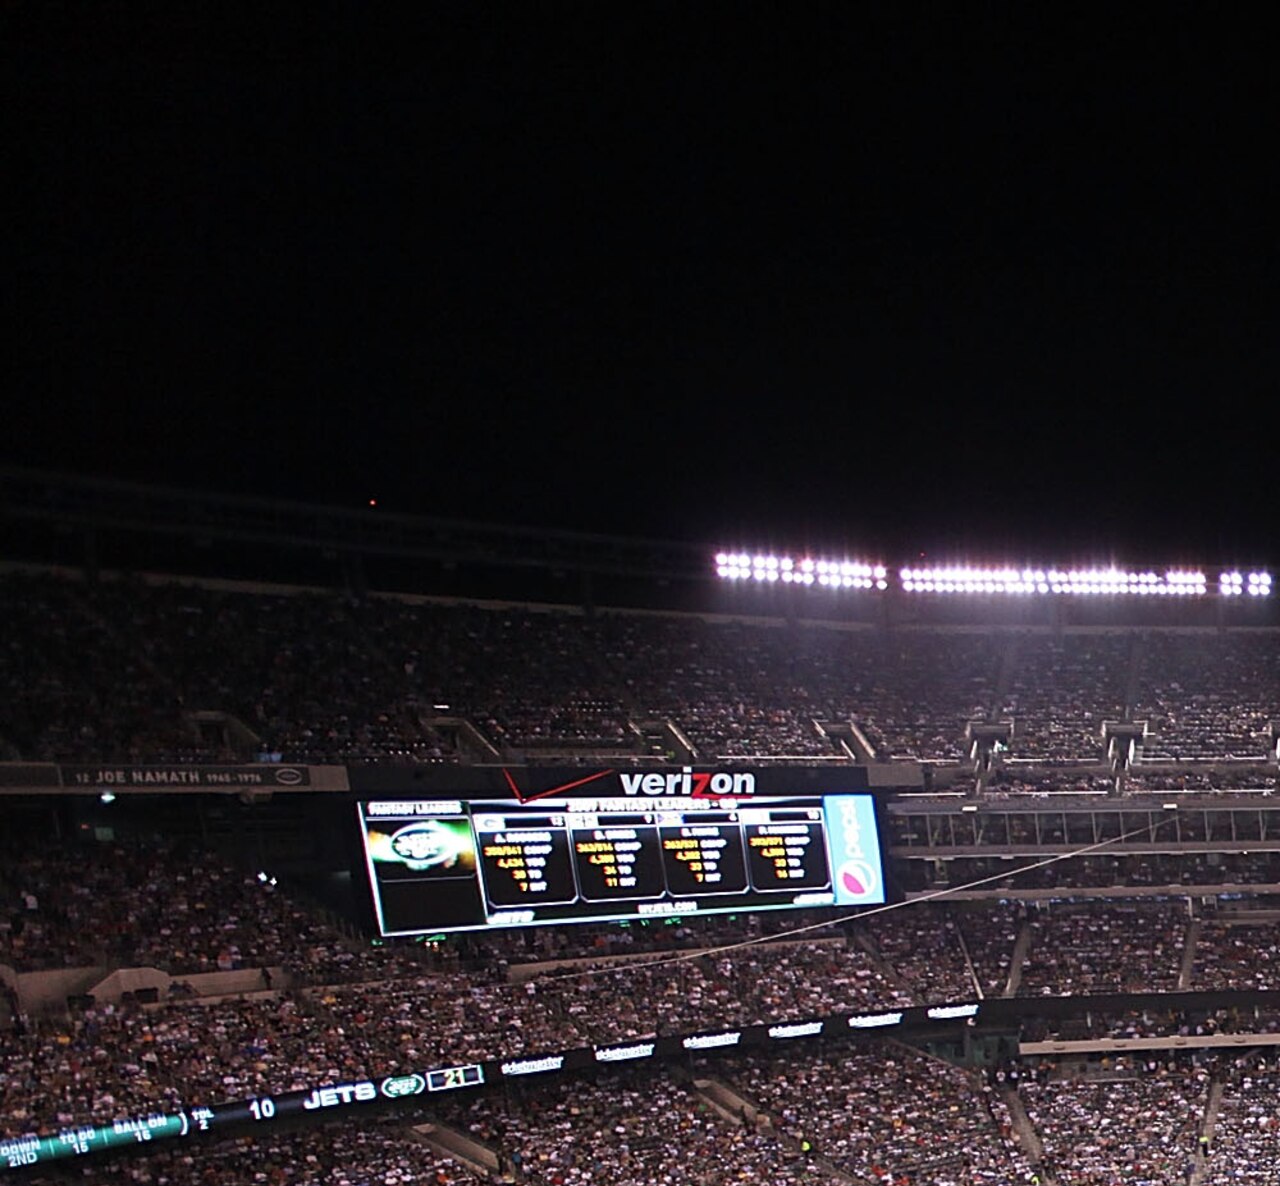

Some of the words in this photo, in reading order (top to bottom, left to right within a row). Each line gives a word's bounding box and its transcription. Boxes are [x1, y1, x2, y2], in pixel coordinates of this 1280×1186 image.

[96, 771, 126, 784] JOE
[132, 770, 200, 784] NAMATH
[620, 767, 755, 799] verizon
[599, 800, 654, 812] FANTASY
[655, 798, 710, 811] LEADERS
[443, 1069, 465, 1087] 21
[249, 1099, 275, 1120] 10
[303, 1081, 377, 1111] JETS
[113, 1119, 146, 1135] BALL
[199, 1119, 209, 1131] 2
[9, 1152, 38, 1167] 2ND
